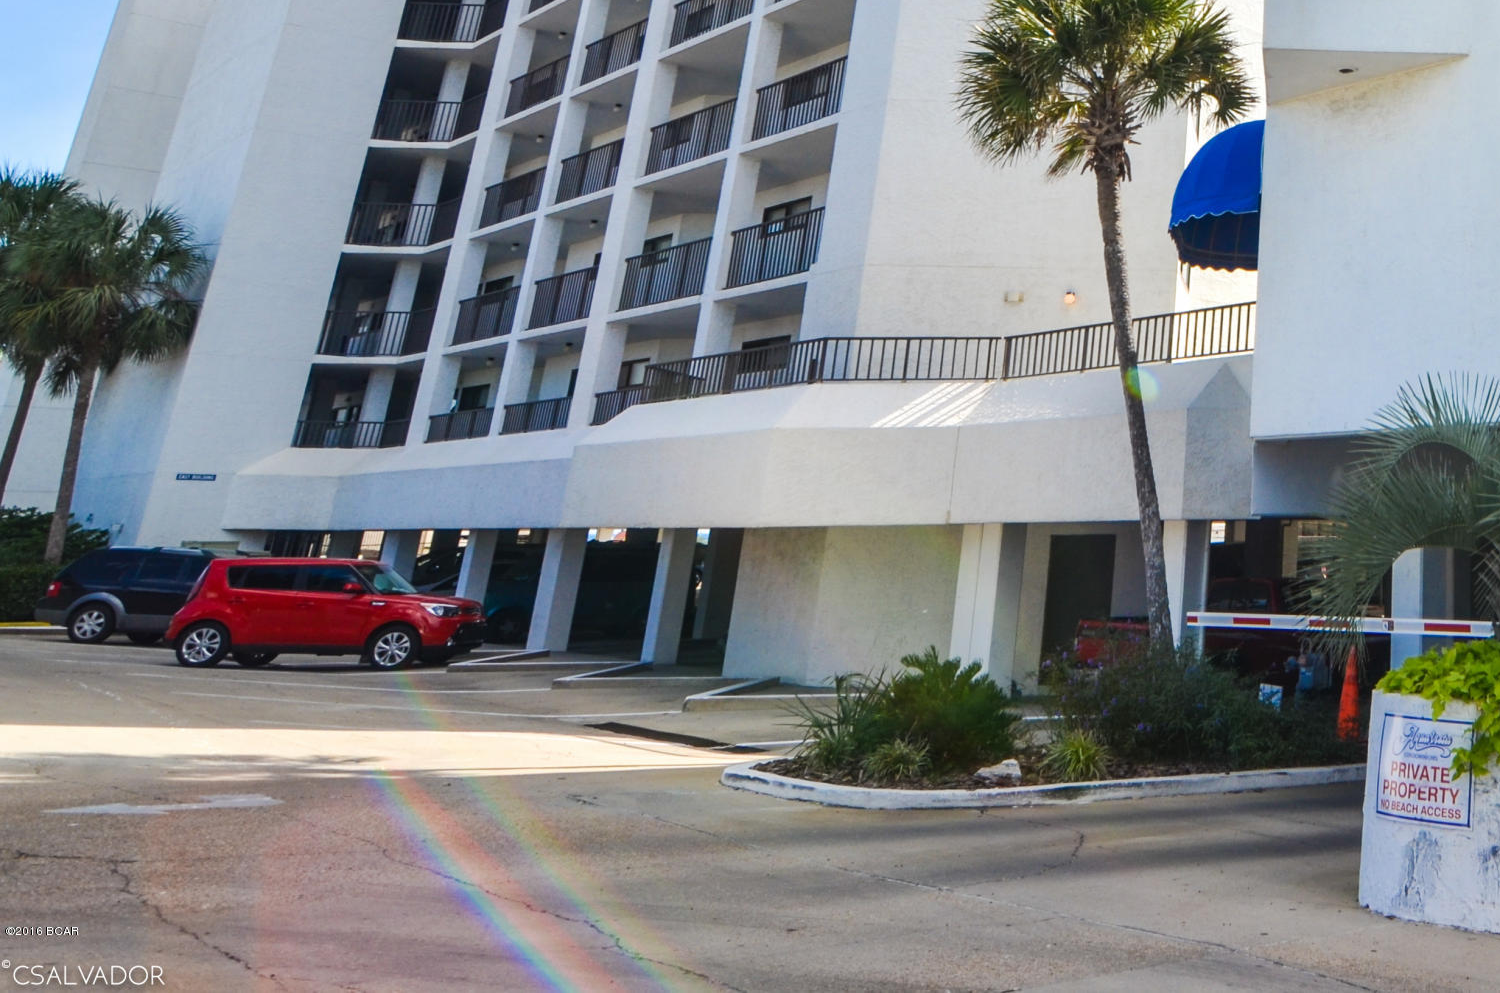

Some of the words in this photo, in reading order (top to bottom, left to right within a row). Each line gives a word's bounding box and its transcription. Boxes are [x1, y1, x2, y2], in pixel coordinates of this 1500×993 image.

[1390, 761, 1451, 784] PRIVATE
[1382, 779, 1460, 805] PROPERTY
[1380, 799, 1390, 809] NO
[1391, 802, 1418, 814] BEACH
[1421, 807, 1462, 820] ACCESS
